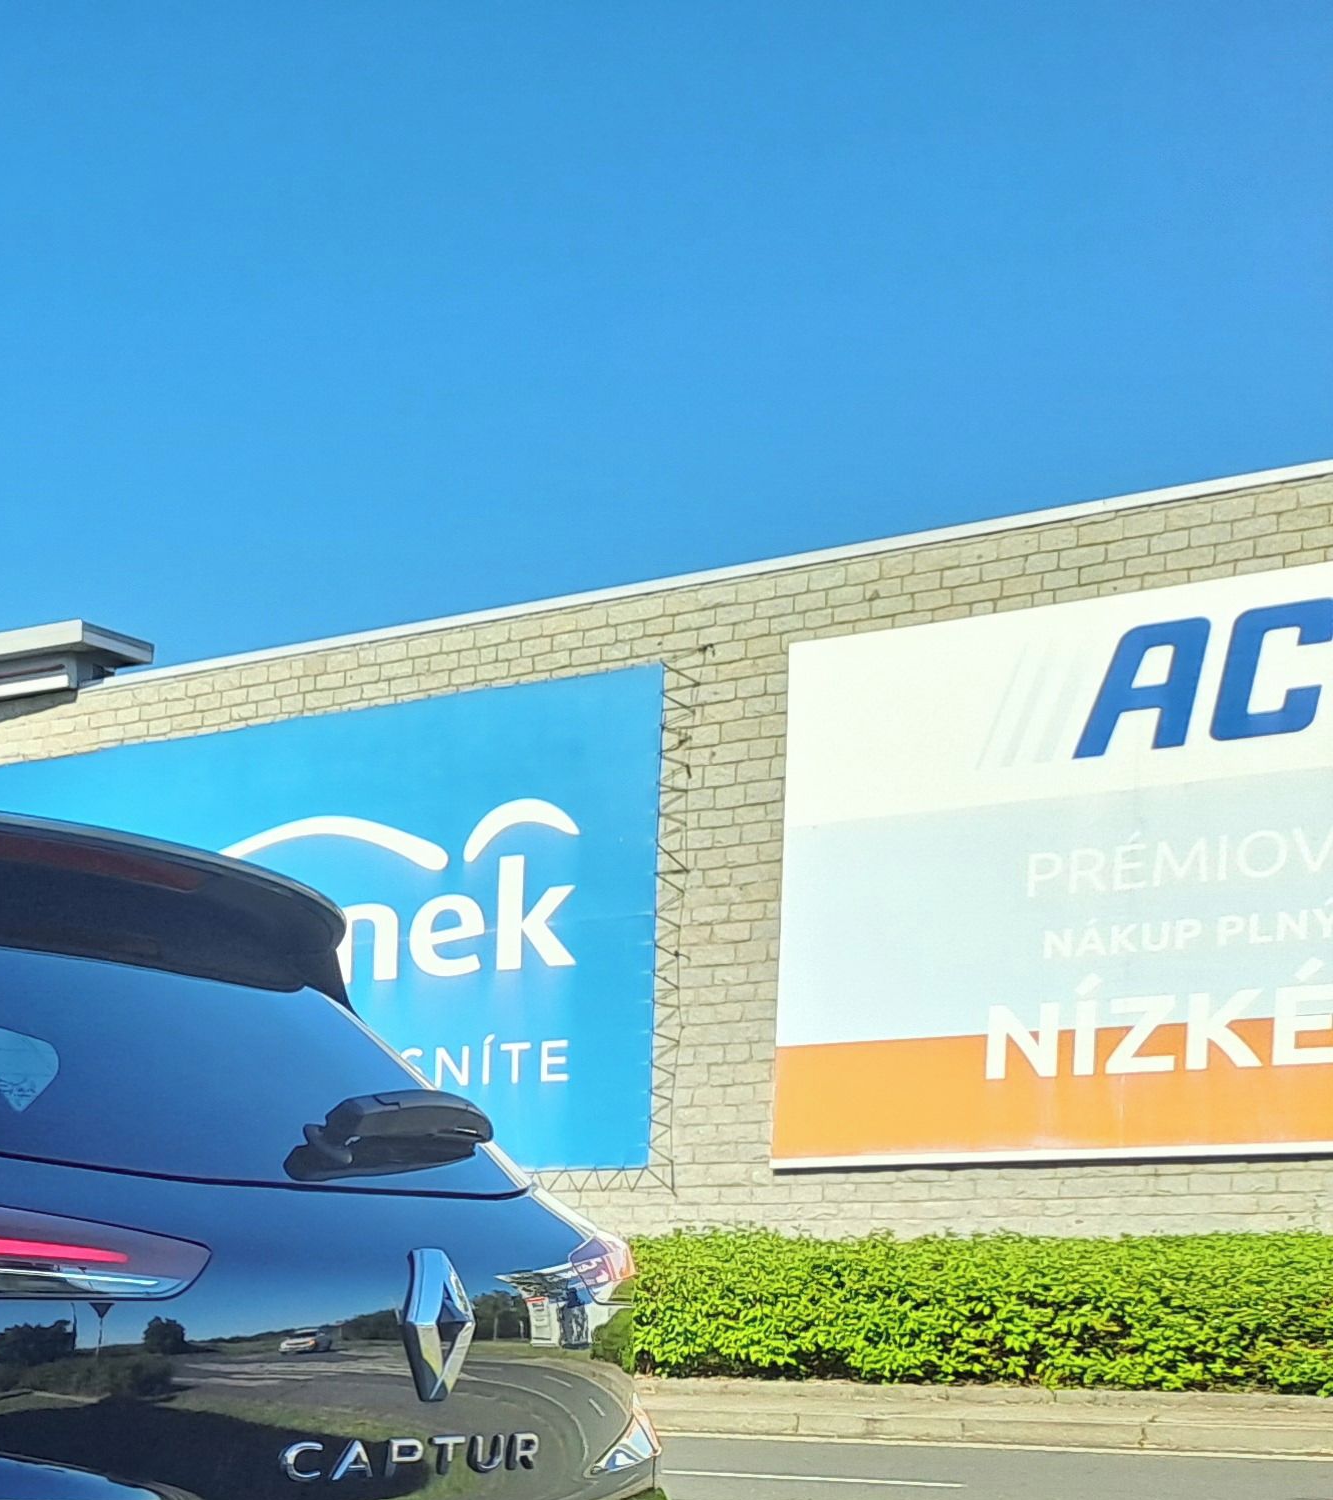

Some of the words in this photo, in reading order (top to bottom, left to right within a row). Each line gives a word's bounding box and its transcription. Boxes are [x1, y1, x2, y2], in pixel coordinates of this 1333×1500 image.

[1071, 597, 1333, 760] AC
[1026, 827, 1333, 897] PRÉMIOV
[1043, 918, 1203, 959] NÁKUP
[985, 957, 1333, 1080] NÍZKÉ
[280, 1432, 540, 1483] CAPTUR
